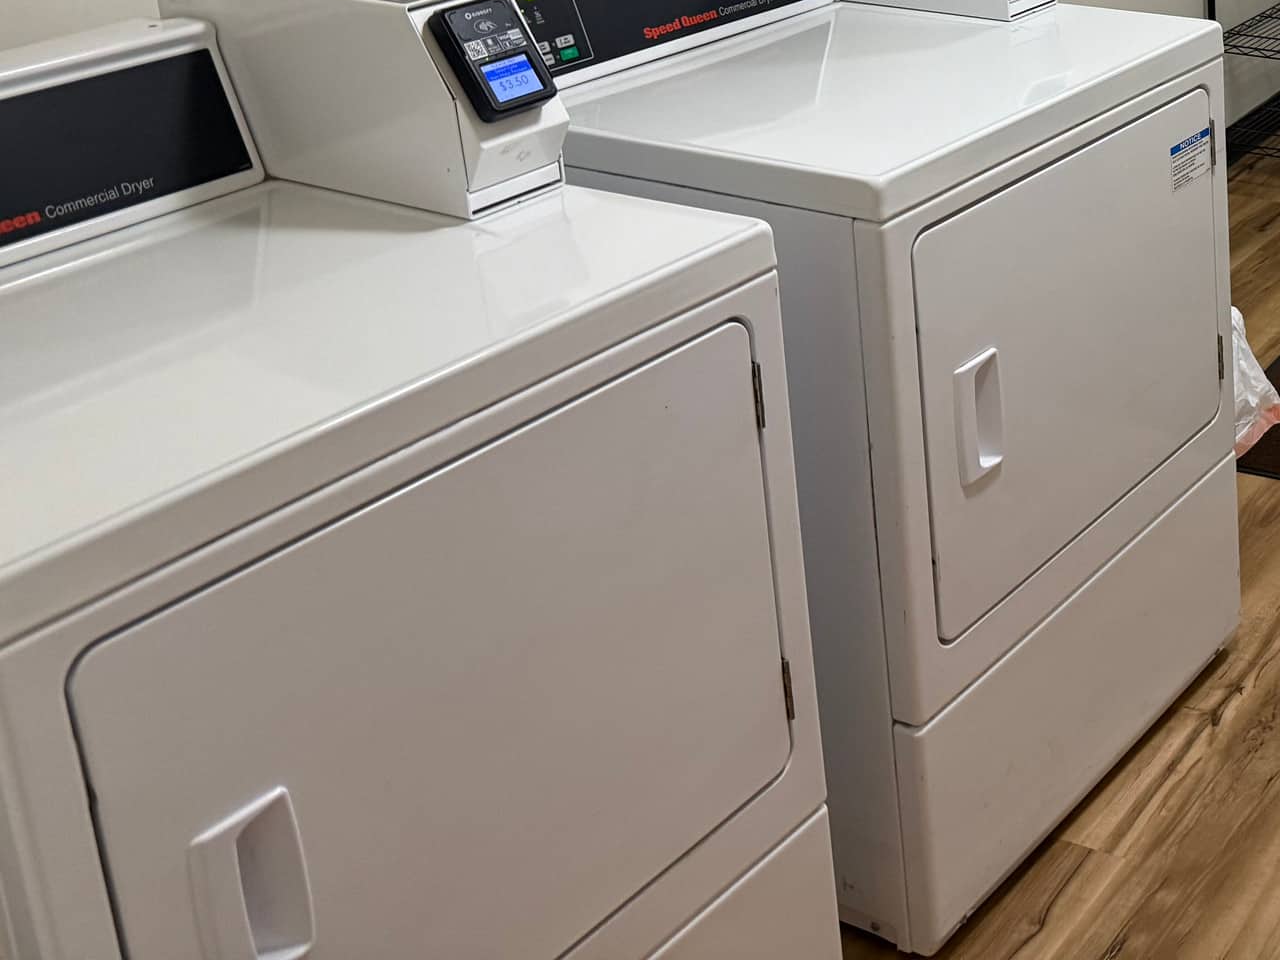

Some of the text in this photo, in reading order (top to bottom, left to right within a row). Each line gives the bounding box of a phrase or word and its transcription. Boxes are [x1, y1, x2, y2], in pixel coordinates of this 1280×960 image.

[643, 18, 682, 39] Speed
[681, 9, 718, 28] Queen
[1180, 134, 1202, 150] NOTICE
[0, 176, 154, 234] een Commercial Dryer
